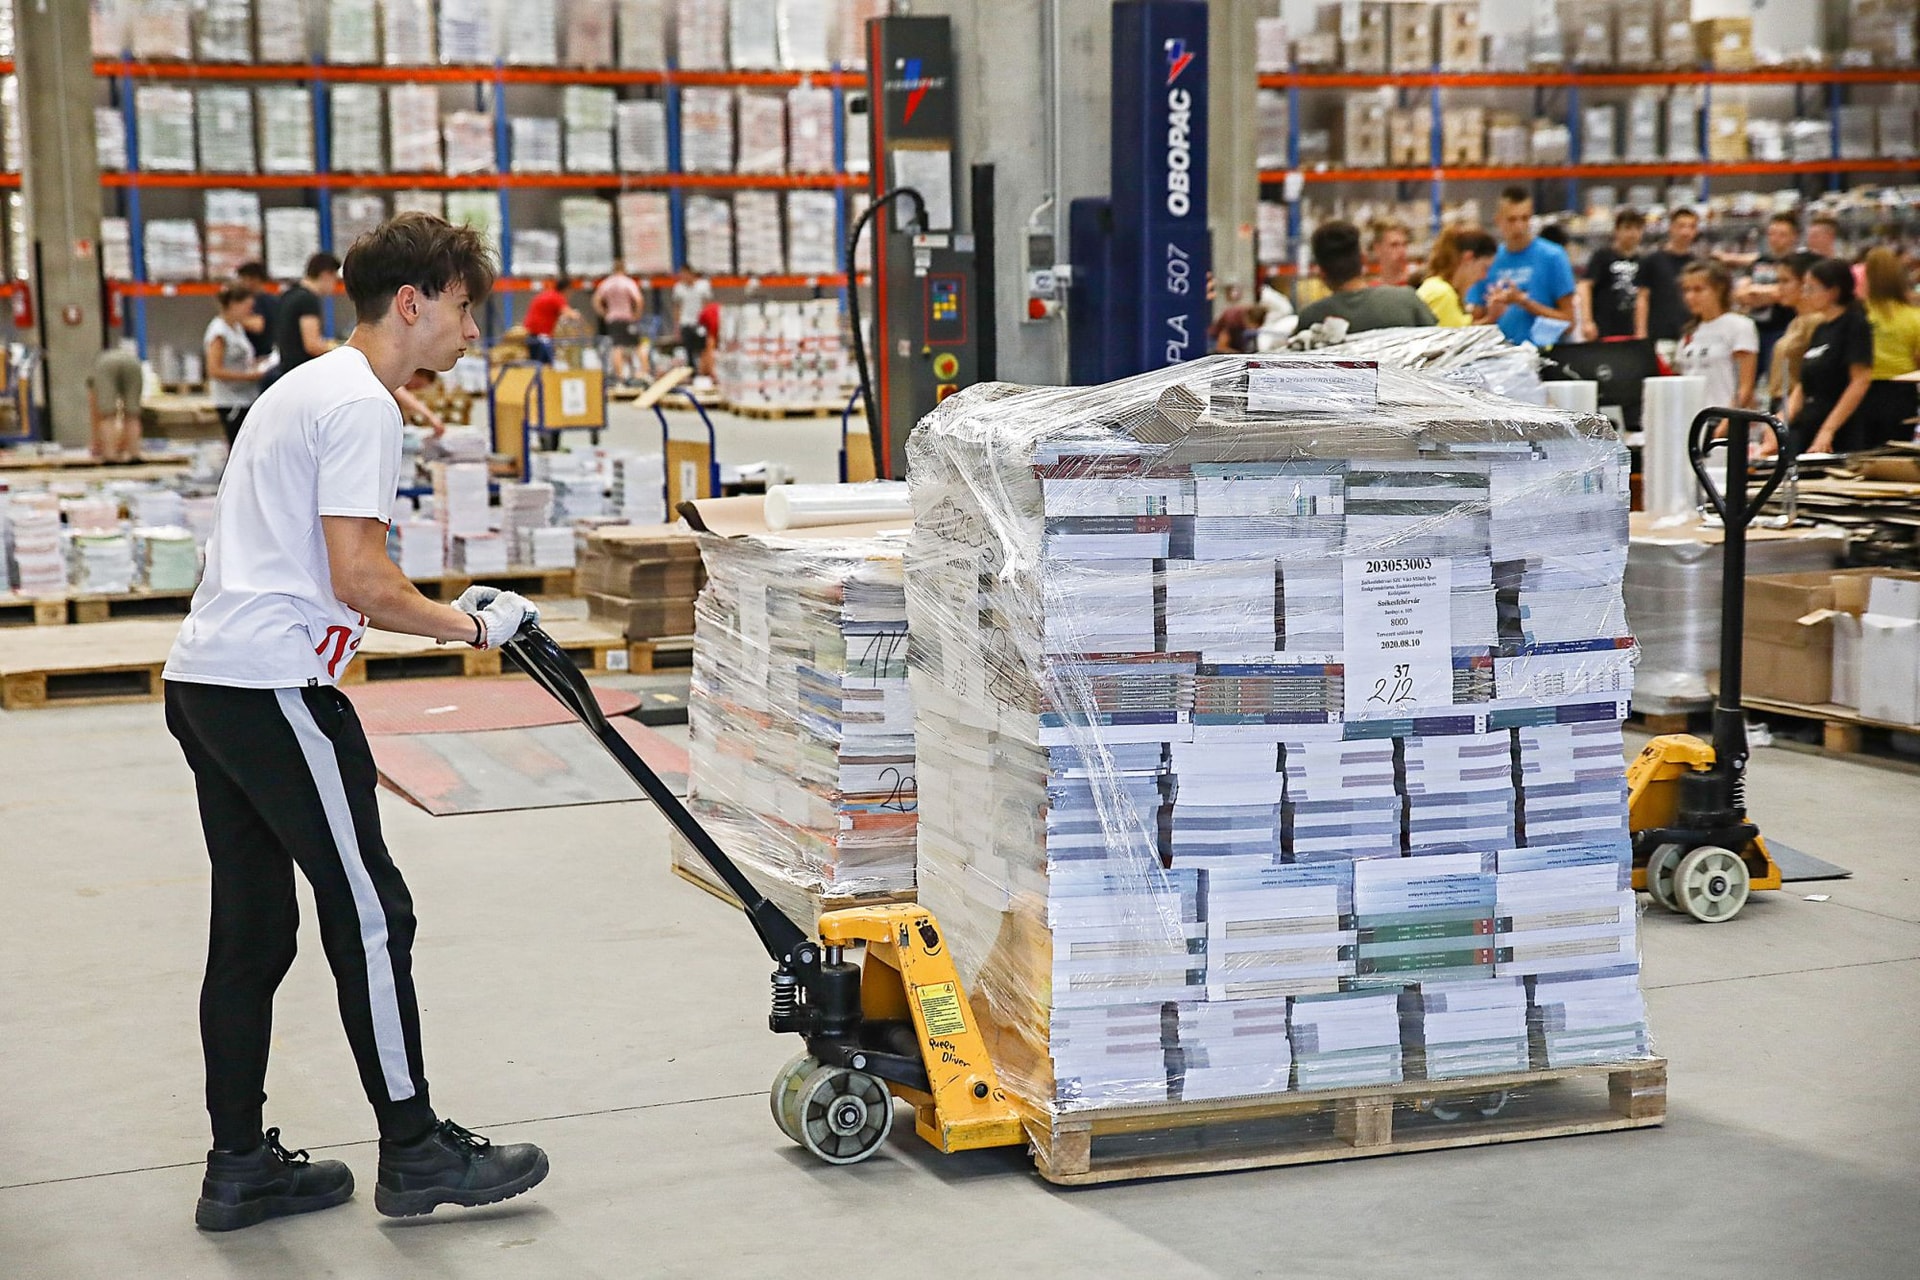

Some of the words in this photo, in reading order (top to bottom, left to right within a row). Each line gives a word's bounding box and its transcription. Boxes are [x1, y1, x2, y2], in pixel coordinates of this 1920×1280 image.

[1167, 88, 1192, 217] OBOPAC
[1167, 242, 1190, 296] 507
[1366, 557, 1432, 573] 203053003
[1377, 597, 1421, 607] Székesfehérvár
[1390, 617, 1409, 627] 8000
[1380, 639, 1421, 649] 2020.08.10
[1393, 664, 1410, 679] 37
[1367, 678, 1417, 705] 2/2
